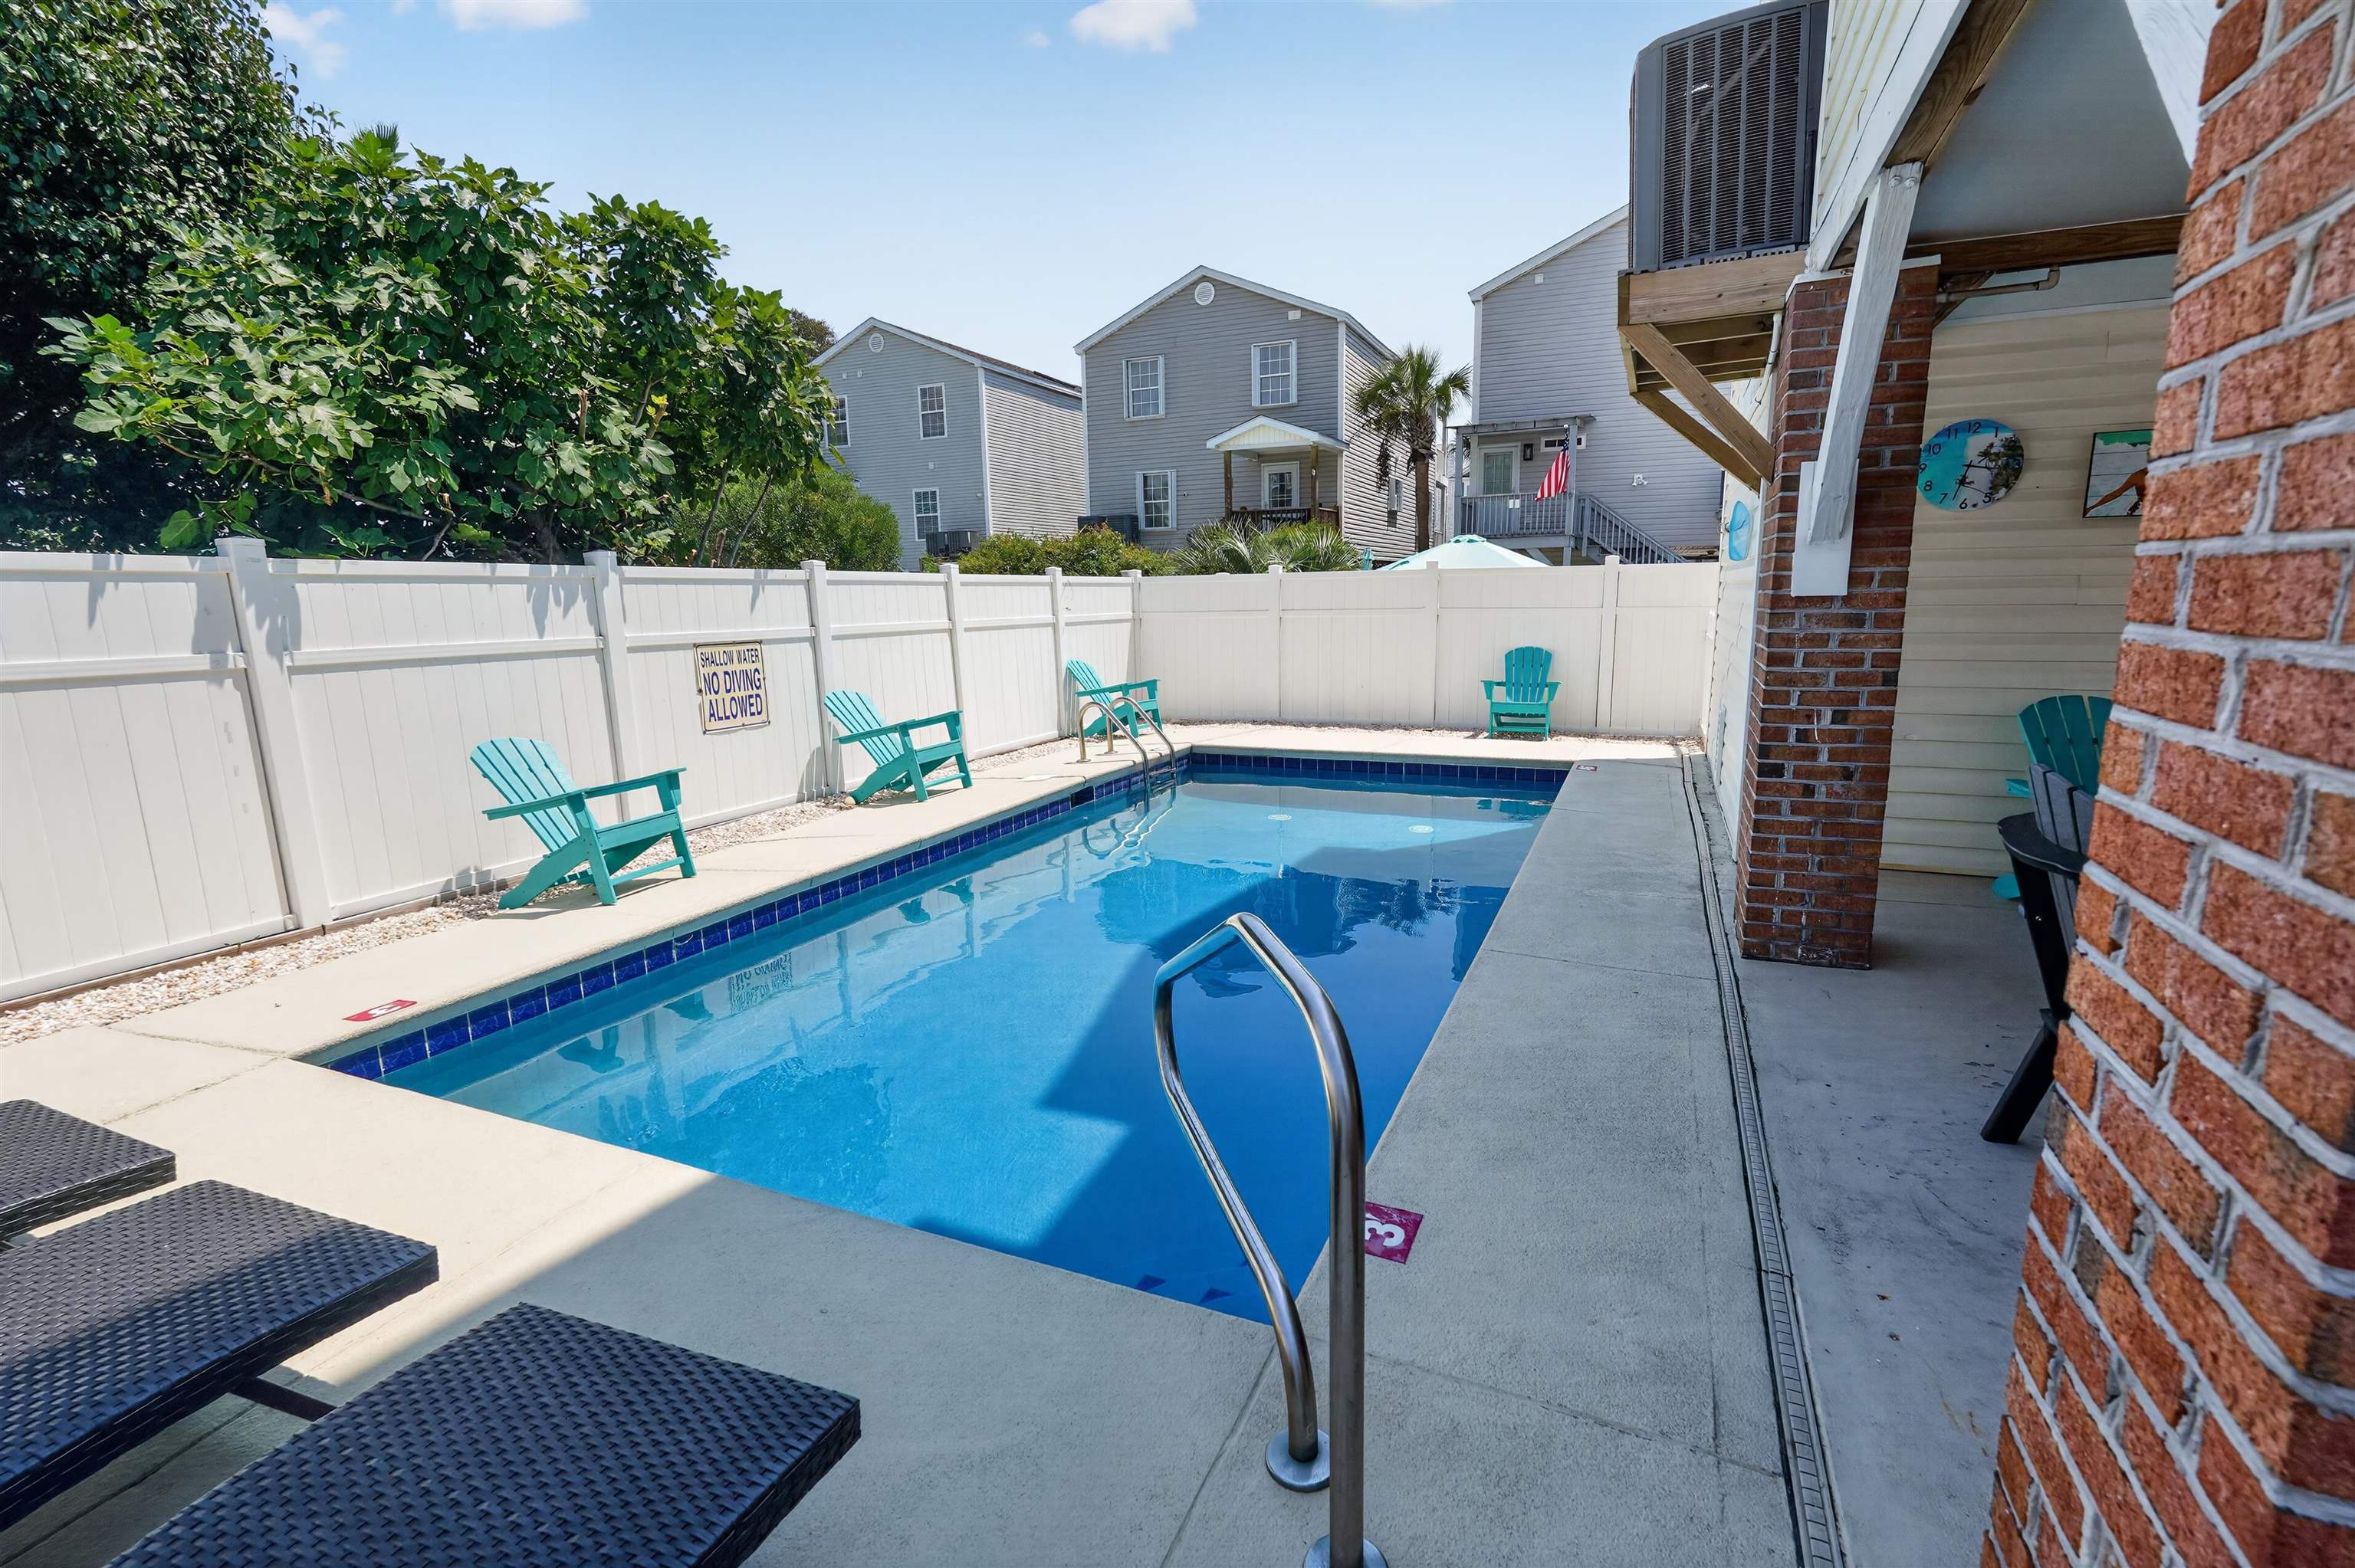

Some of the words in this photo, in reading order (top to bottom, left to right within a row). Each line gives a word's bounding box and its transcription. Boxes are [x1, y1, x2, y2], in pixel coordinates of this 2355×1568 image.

[1968, 422, 1982, 434] 12
[1994, 426, 1999, 438] 1
[1946, 428, 1958, 441] 11
[1926, 443, 1942, 454] 10
[1919, 463, 1927, 474] 9
[1923, 480, 1933, 491] 8
[1939, 492, 1949, 504] 7
[1959, 498, 1968, 510] 6
[700, 649, 734, 668] SHALLOW
[736, 648, 760, 664] WATER
[703, 671, 720, 696] NO
[723, 668, 762, 694] DIVING
[709, 693, 763, 722] ALLOWED
